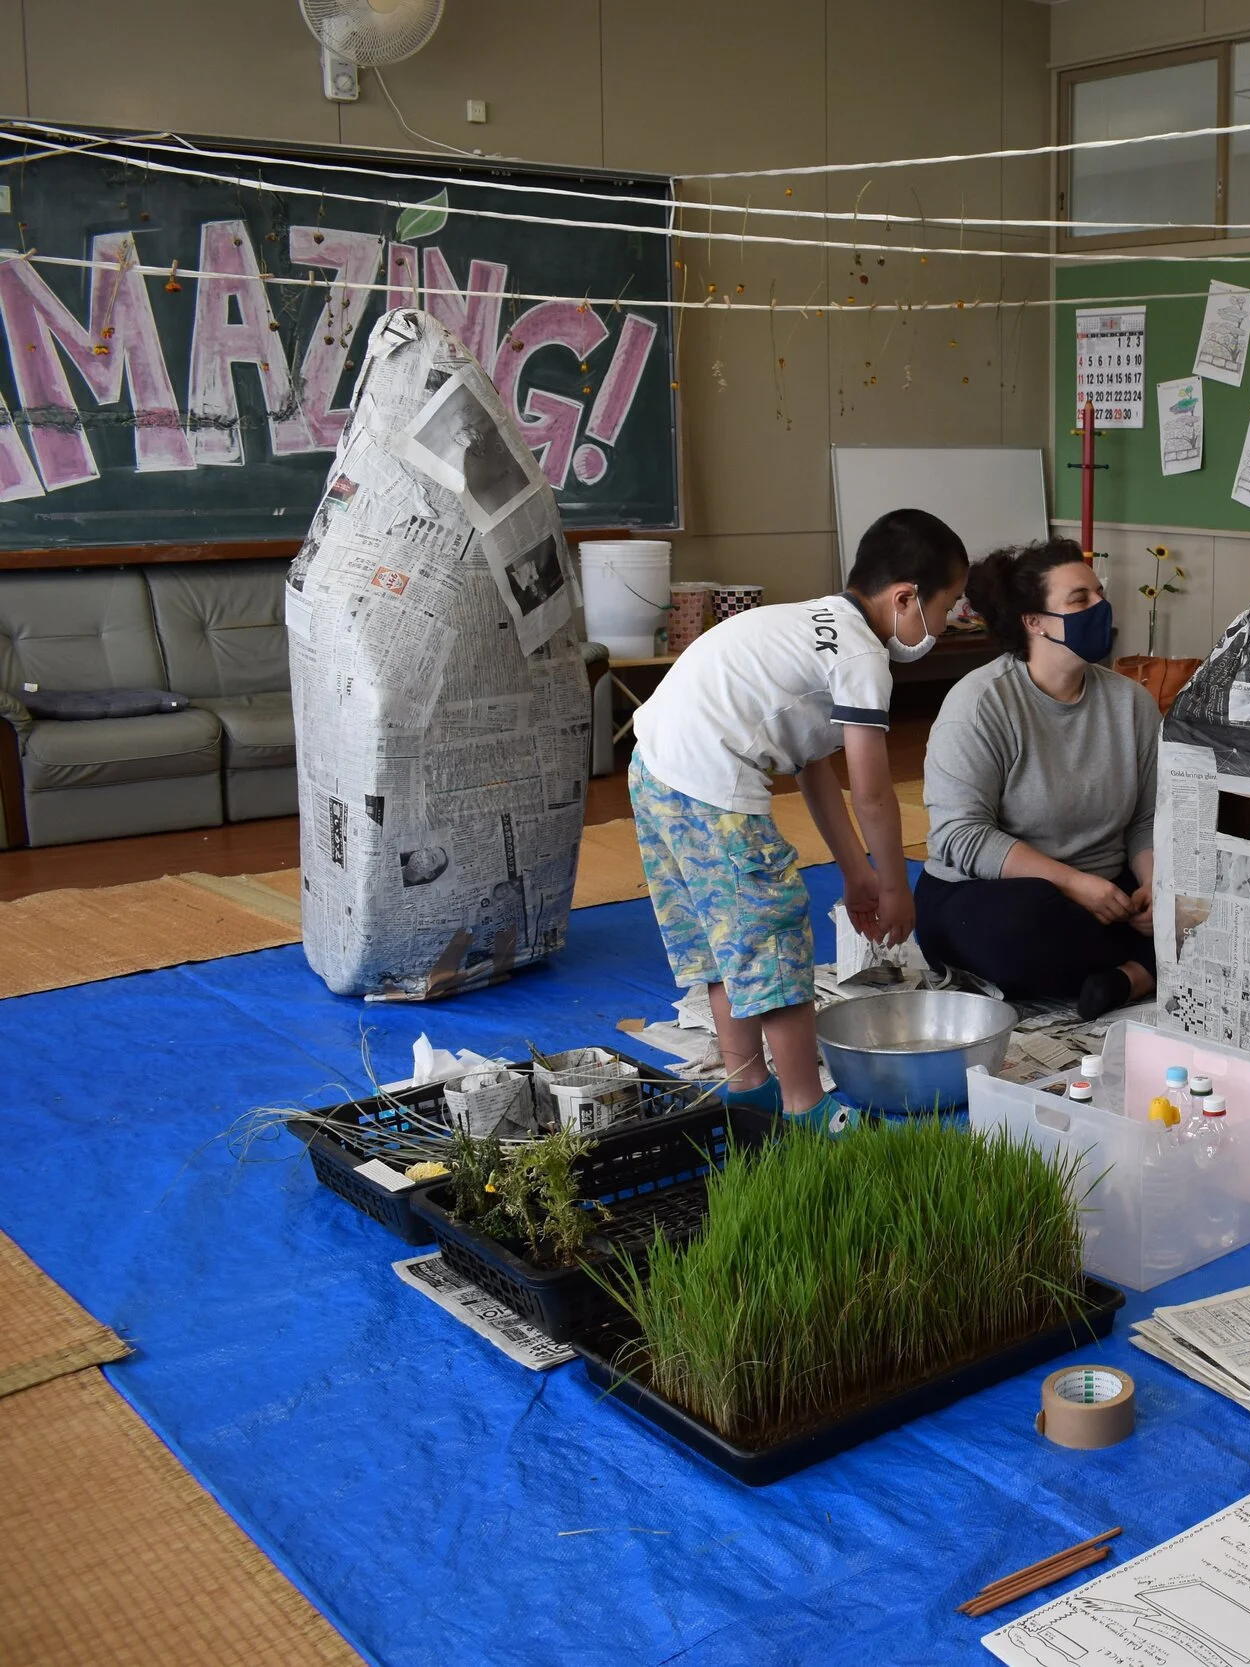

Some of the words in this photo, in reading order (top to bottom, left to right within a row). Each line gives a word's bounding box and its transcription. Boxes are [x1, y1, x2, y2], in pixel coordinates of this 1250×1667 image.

[1118, 337, 1121, 348] 1
[1127, 337, 1131, 348] 2
[1136, 336, 1141, 347] 3
[1079, 355, 1083, 367] 4
[1088, 355, 1093, 366] 5
[1098, 355, 1103, 366] 6
[1107, 355, 1112, 366] 7
[1117, 355, 1121, 366] 8
[1126, 355, 1131, 366] 9
[1134, 354, 1142, 365] 10
[1078, 374, 1084, 385] 11
[1087, 374, 1094, 385] 12
[1096, 374, 1104, 384] 13
[1106, 374, 1113, 384] 14
[1116, 373, 1123, 384] 15
[1125, 373, 1132, 384] 16
[1134, 372, 1142, 383] 17
[1078, 392, 1084, 402] 18
[1086, 391, 1094, 401] 19
[1096, 392, 1104, 402] 20
[1105, 392, 1113, 402] 21
[1114, 391, 1122, 402] 22
[1124, 391, 1132, 401] 23
[1133, 391, 1142, 401] 24
[1095, 409, 1103, 420] 27
[1104, 409, 1113, 420] 28
[1114, 409, 1123, 420] 29
[1123, 408, 1131, 420] 30
[1170, 770, 1184, 778] Gold
[1185, 770, 1202, 780] brings
